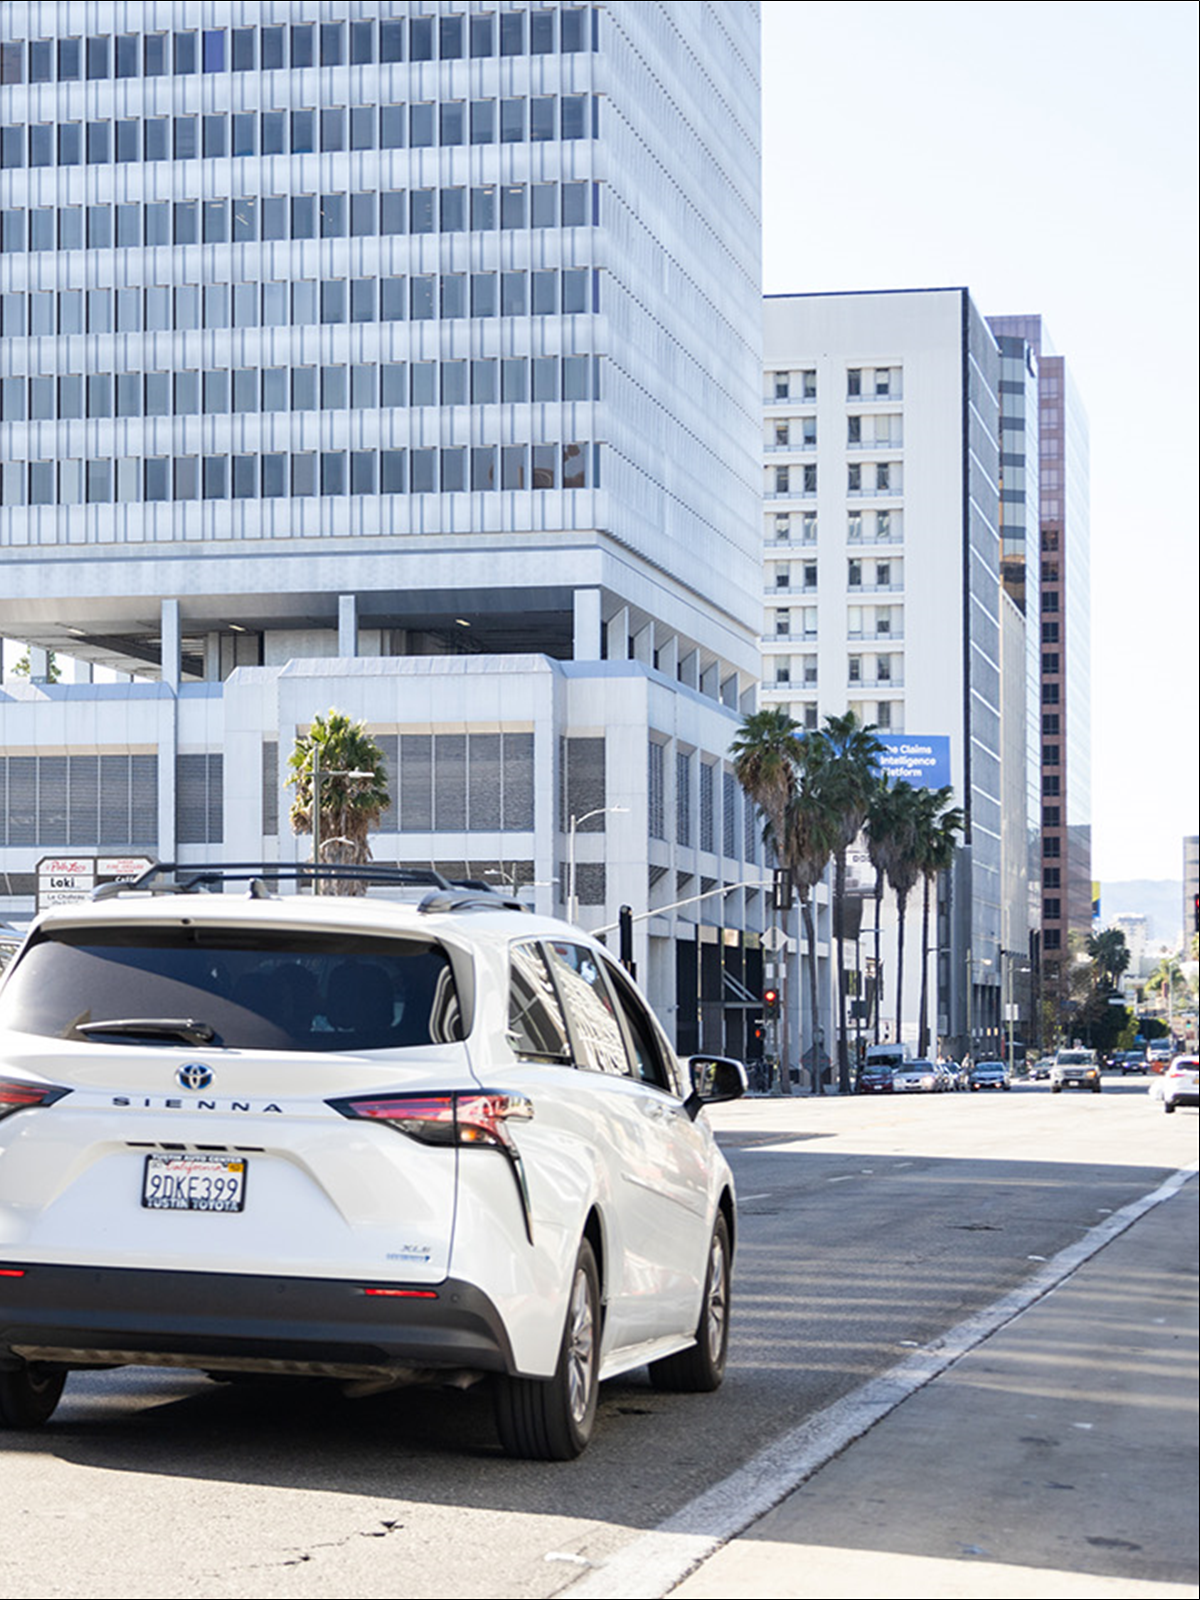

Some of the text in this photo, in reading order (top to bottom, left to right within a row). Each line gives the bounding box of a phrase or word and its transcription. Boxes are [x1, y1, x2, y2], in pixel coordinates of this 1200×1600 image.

[900, 744, 932, 754] Claims
[880, 755, 936, 768] Intelligence
[50, 877, 75, 888] Loki
[112, 1096, 283, 1114] SIENNA
[165, 1160, 229, 1175] California
[150, 1174, 239, 1201] 9DKE399
[147, 1197, 239, 1212] TUSTIN TOYOTA
